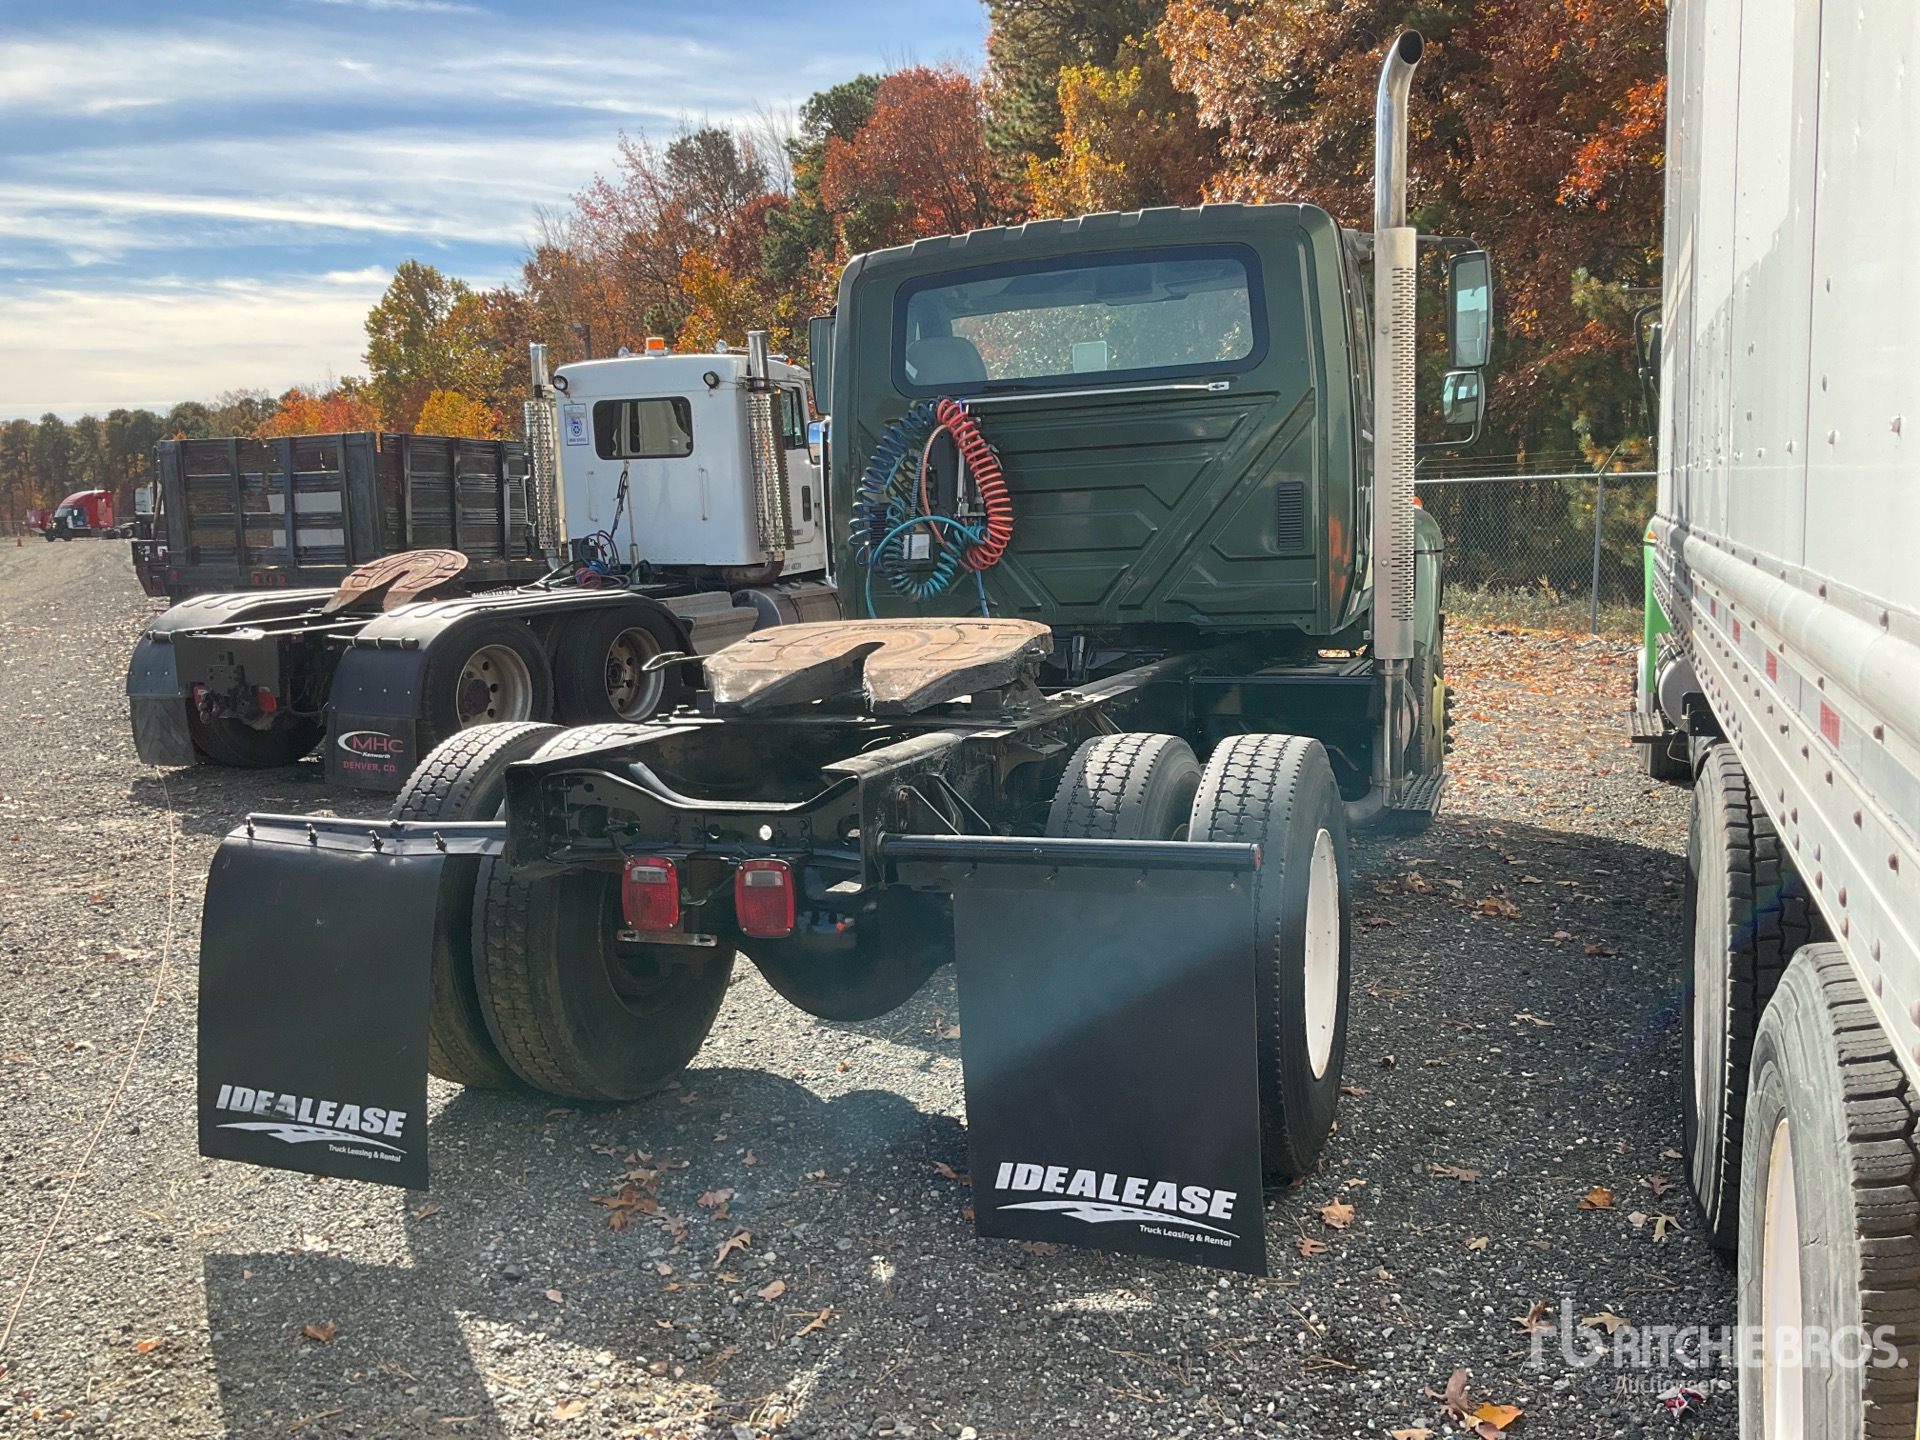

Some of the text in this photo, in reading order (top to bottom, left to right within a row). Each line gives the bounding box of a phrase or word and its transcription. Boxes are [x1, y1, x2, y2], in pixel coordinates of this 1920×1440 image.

[352, 735, 404, 753] MHC
[216, 1084, 407, 1138] IDEALEASE
[328, 1144, 401, 1163] Truck Leasing & Rental
[994, 1162, 1238, 1220] IDEALEASE
[1139, 1224, 1232, 1248] Truck Leasing & Rental
